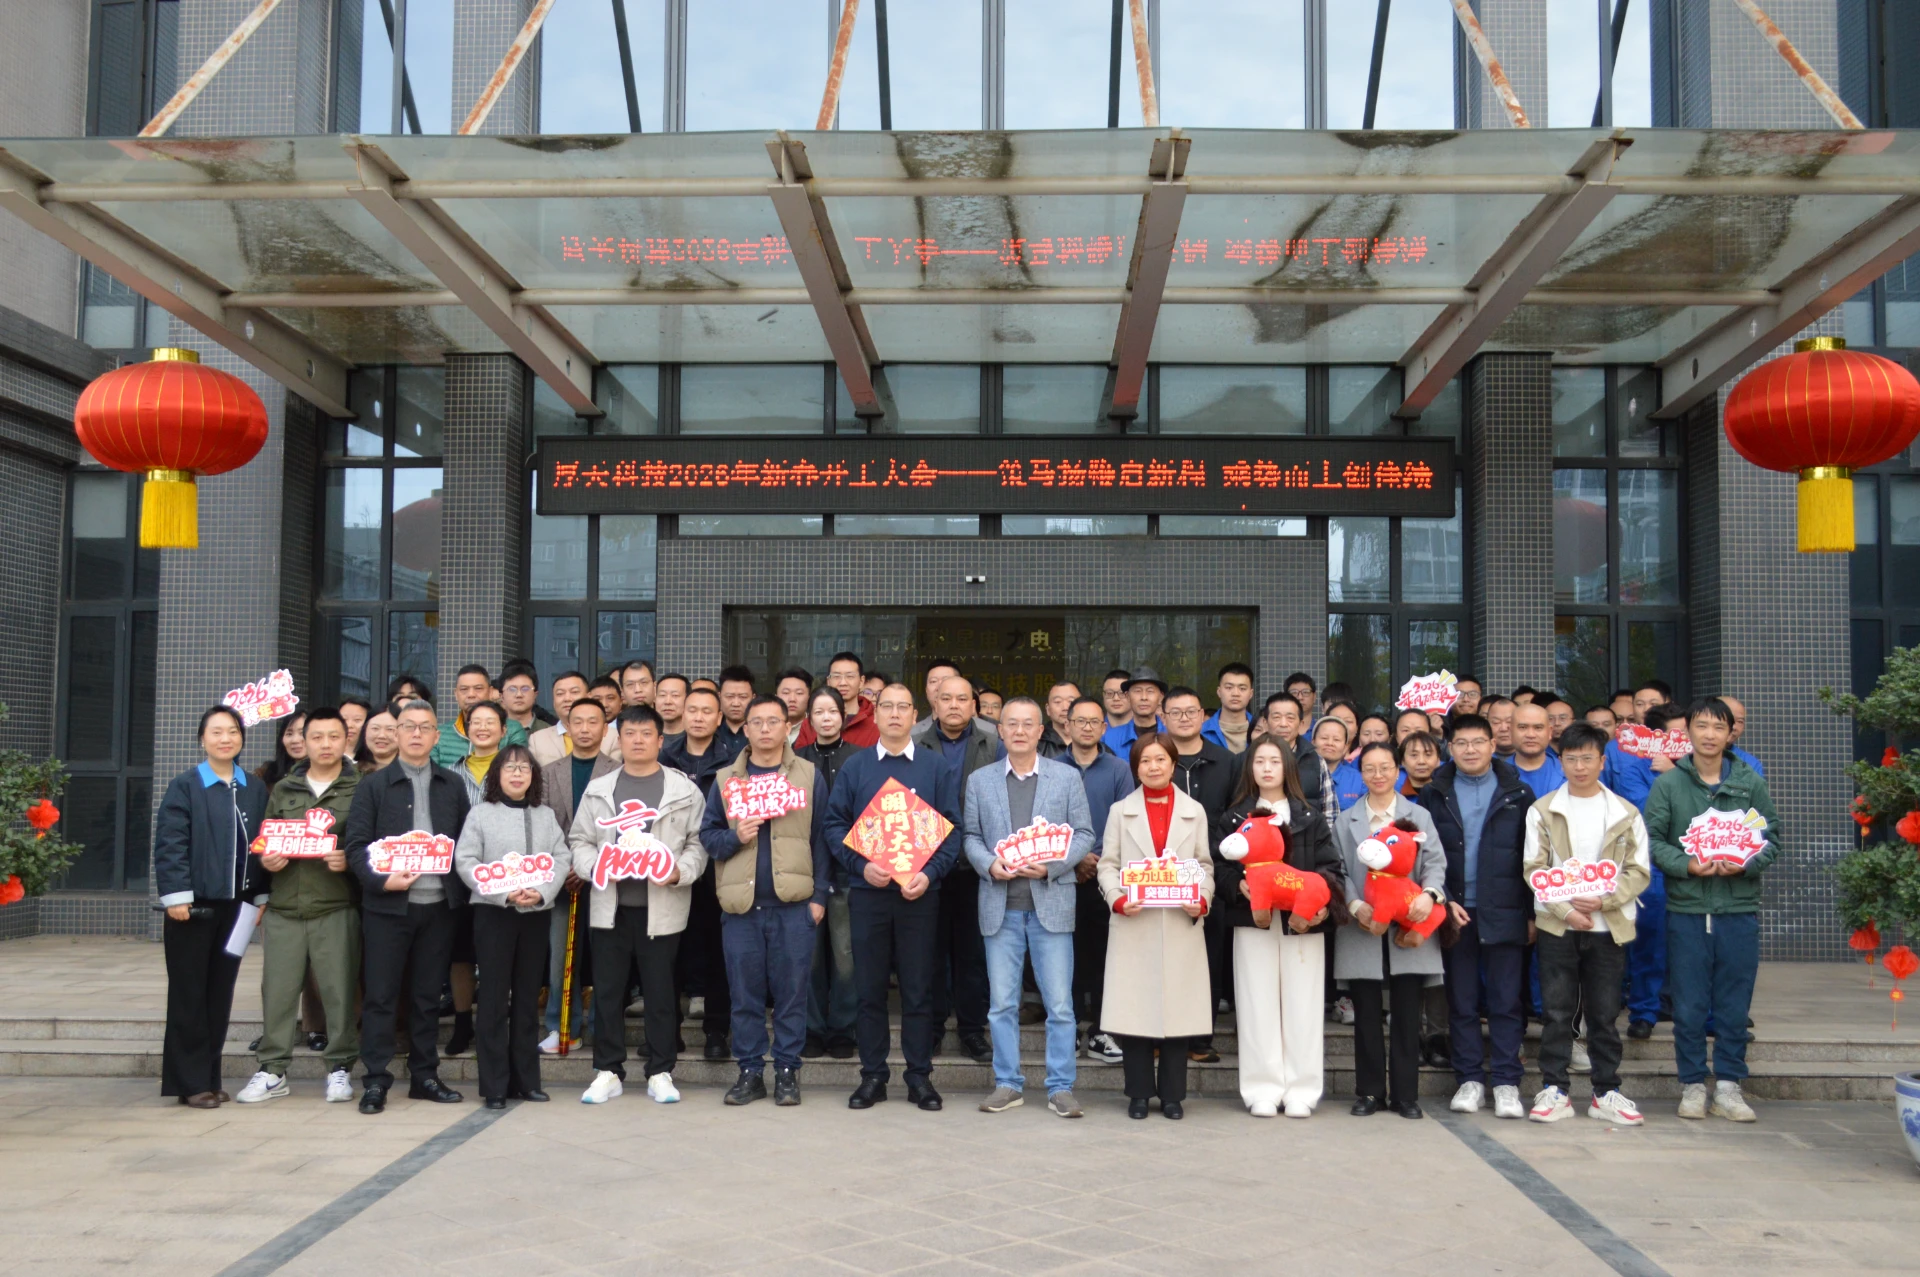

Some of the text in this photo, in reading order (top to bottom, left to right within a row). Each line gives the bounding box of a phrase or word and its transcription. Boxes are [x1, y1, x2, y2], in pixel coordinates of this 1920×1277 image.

[1412, 680, 1440, 694] 2026
[1663, 739, 1693, 753] 2026
[747, 777, 788, 796] 2026
[728, 789, 806, 819] 马到成功!
[263, 822, 306, 836] 2026
[1707, 816, 1743, 832] 2026
[265, 836, 335, 855] 再创佳绩
[1680, 825, 1764, 855] 乘风破浪
[391, 843, 428, 856] 2026
[493, 874, 541, 889] GOOD LUCK
[1126, 871, 1175, 884] 全力以赴
[1535, 866, 1613, 887] 鸿运当头
[1144, 886, 1194, 900] 突破自我
[1550, 884, 1601, 898] GOOD LUCK
